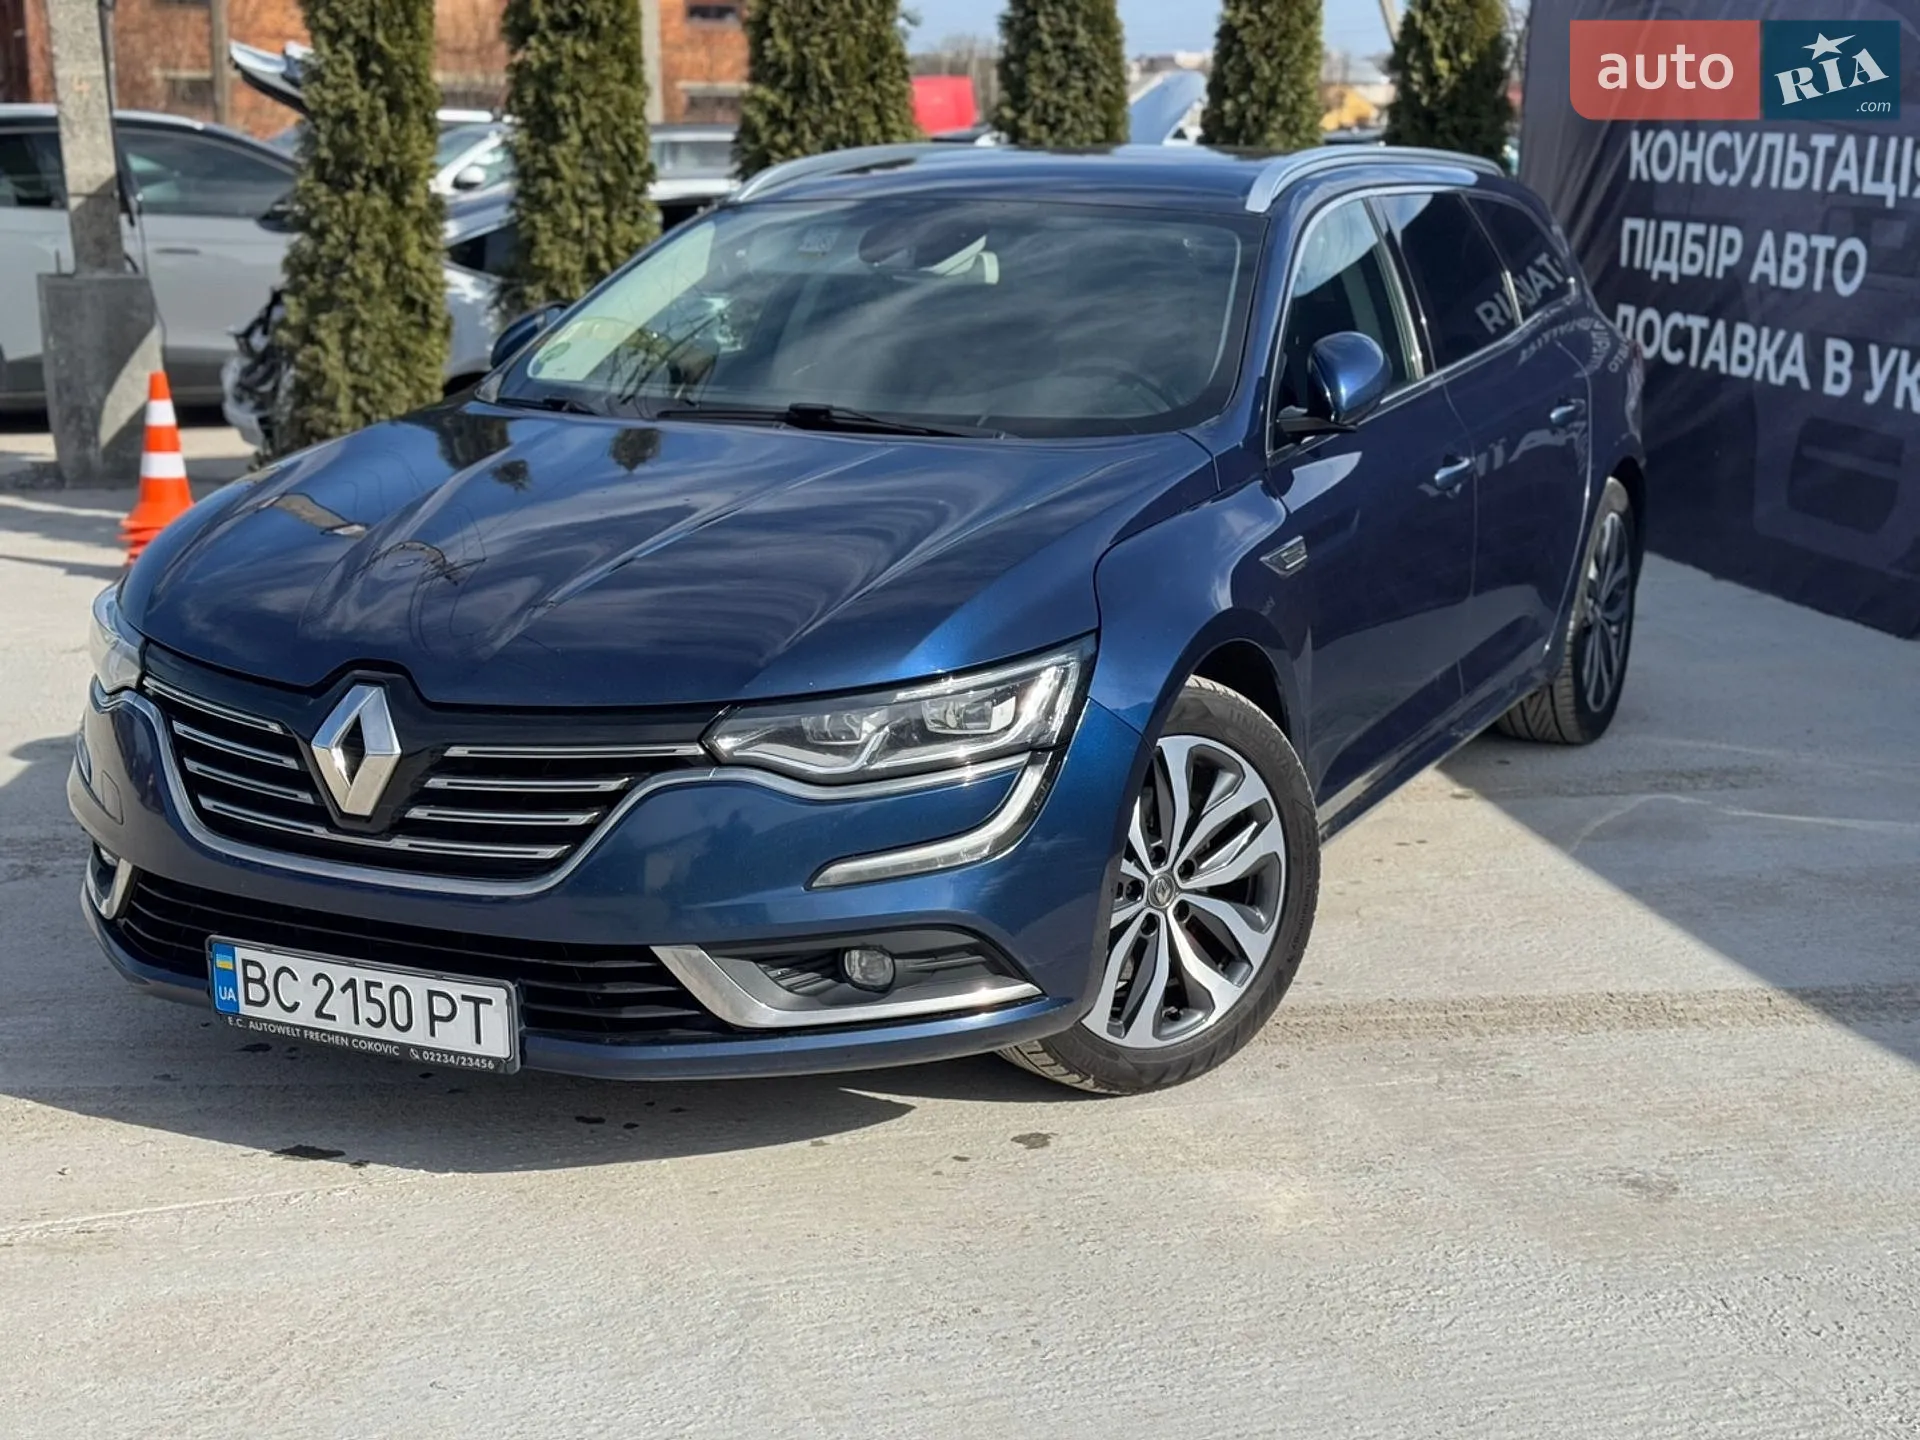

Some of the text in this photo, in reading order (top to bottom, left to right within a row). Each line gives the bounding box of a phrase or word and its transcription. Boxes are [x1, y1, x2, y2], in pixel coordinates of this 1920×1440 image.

[1628, 129, 1920, 208] КОНСУЛЬТАЦІ
[1620, 217, 1868, 297] ПІДБІР АВТО
[1823, 337, 1854, 396] В
[218, 986, 236, 1002] UA
[241, 958, 494, 1045] BC 2150 PT
[228, 1016, 495, 1070] E.C. AUTOWELT FRECHEN COKOVIC 02234/23456
